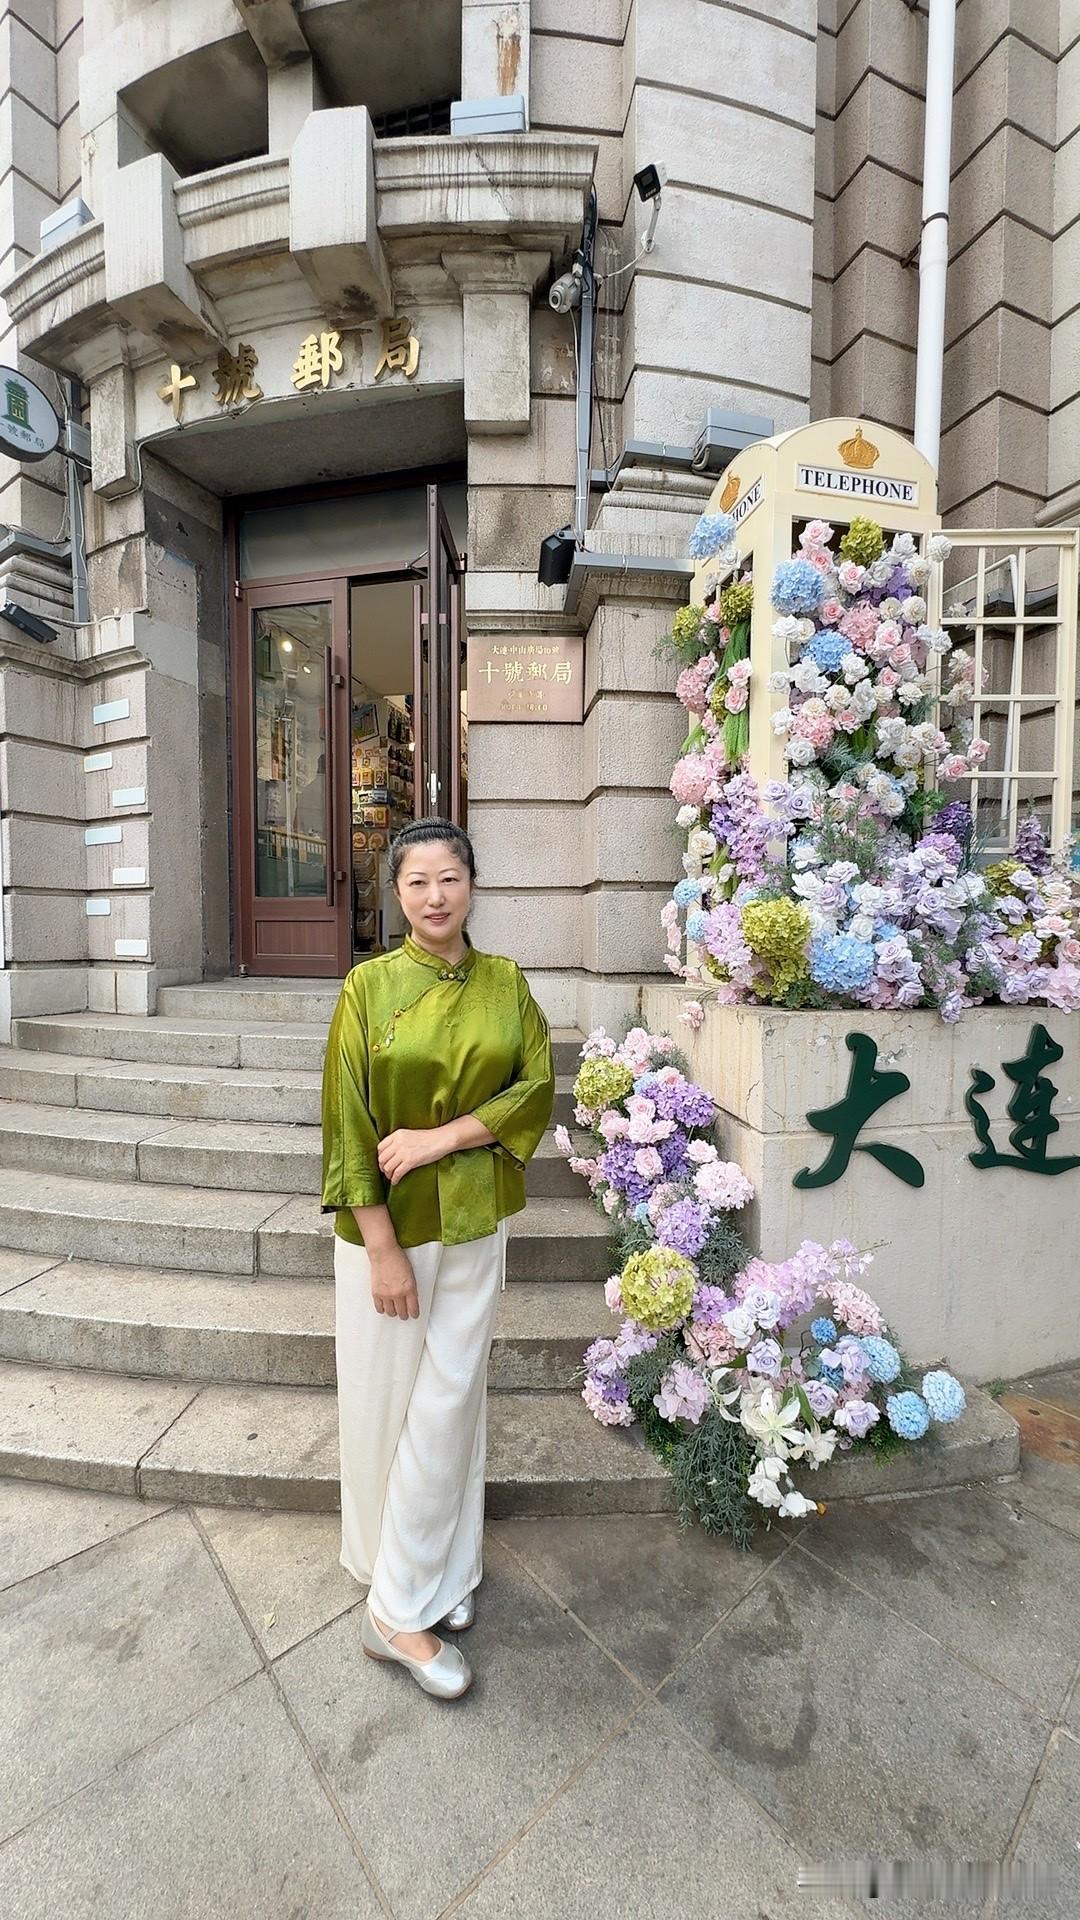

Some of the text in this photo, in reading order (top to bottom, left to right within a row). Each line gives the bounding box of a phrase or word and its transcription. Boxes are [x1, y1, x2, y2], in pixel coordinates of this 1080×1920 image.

[157, 316, 420, 422] 十號郵局
[801, 468, 913, 501] TELEPHONE
[478, 660, 573, 685] 十號郵局
